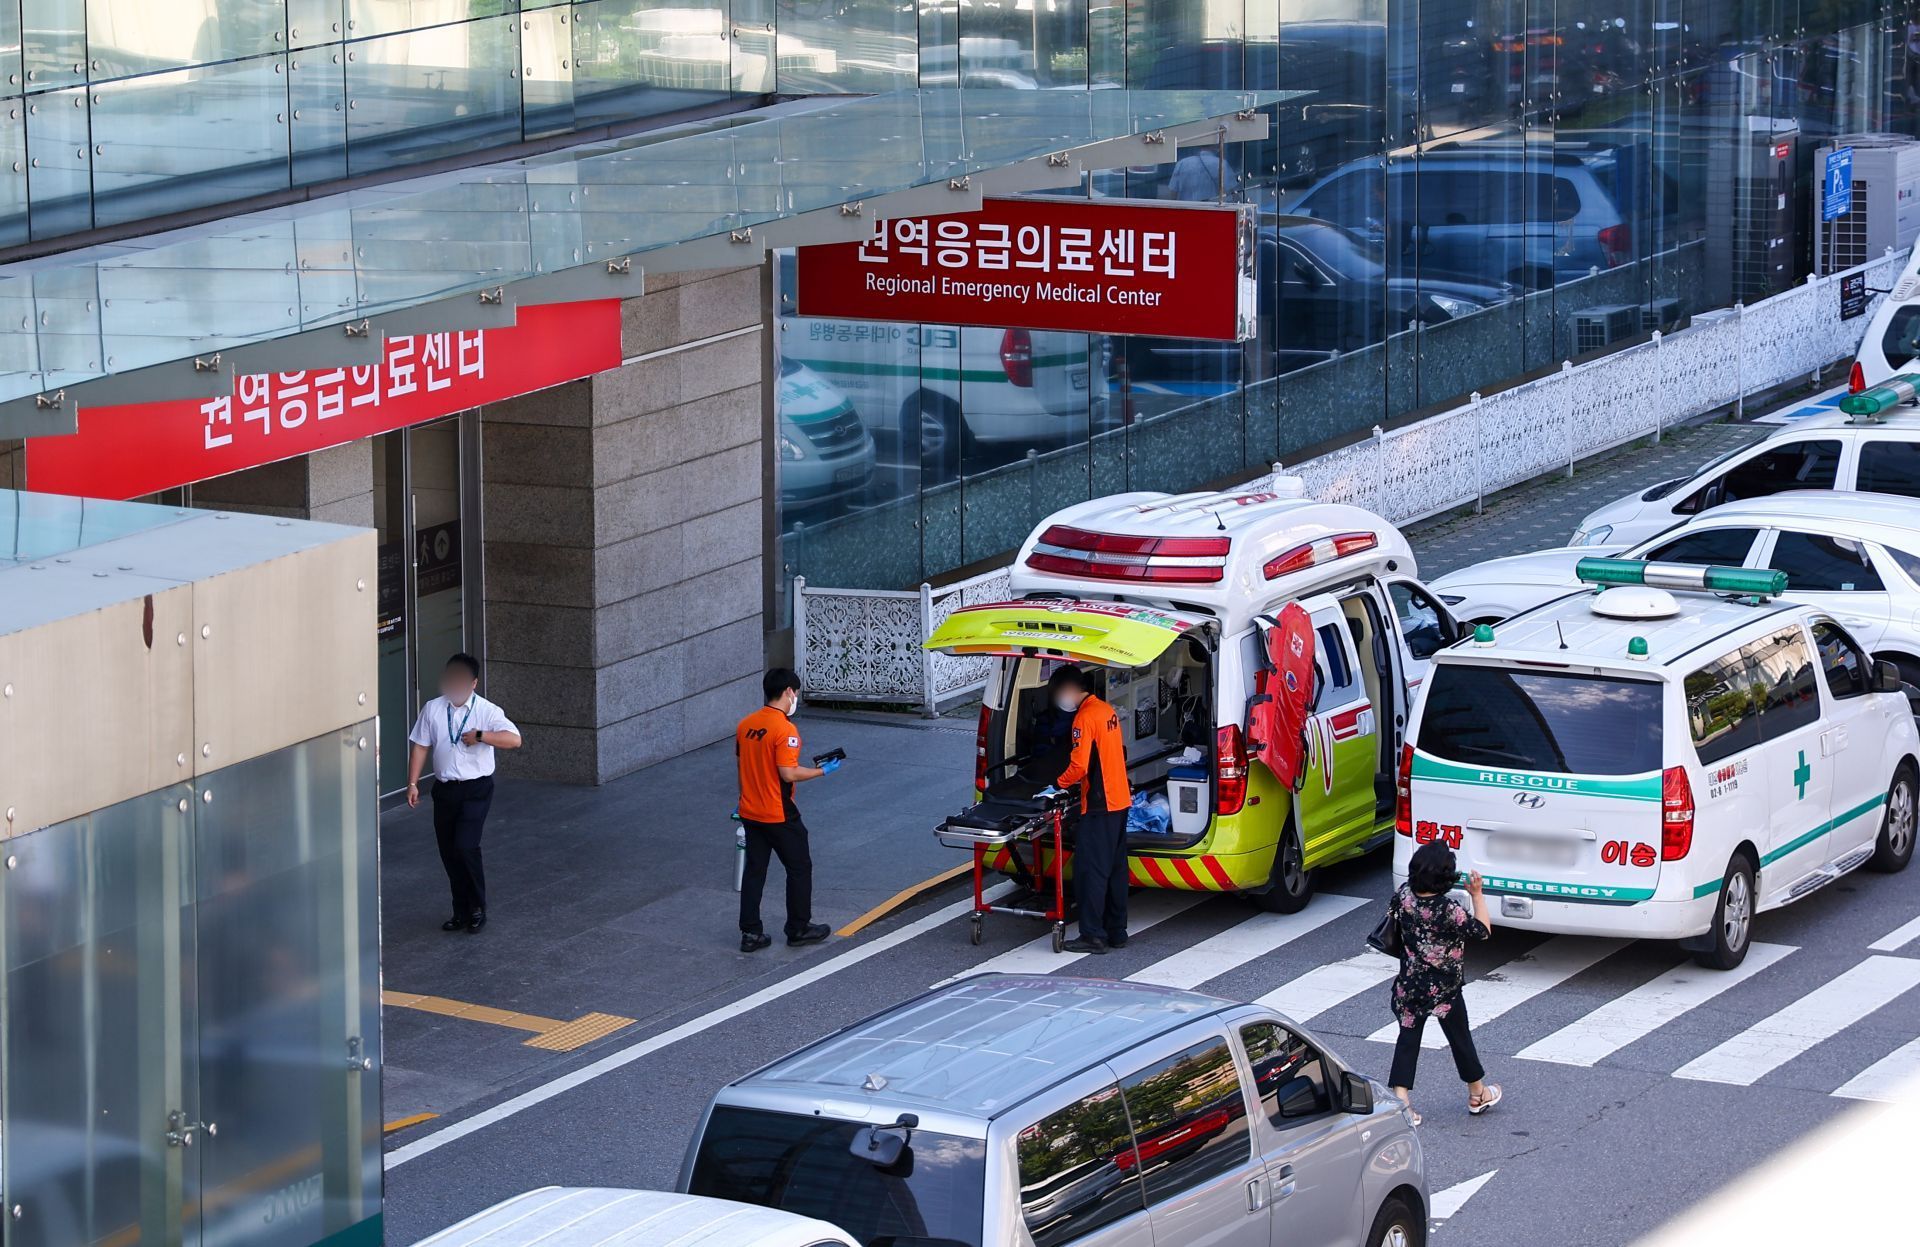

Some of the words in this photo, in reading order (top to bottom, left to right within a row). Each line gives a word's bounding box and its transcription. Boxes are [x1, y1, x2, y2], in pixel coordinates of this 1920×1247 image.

[866, 272, 936, 296] Regional
[942, 277, 1030, 303] Emergency
[1036, 282, 1100, 303] Medical
[1107, 286, 1162, 306] Center
[745, 728, 768, 741] 119
[1479, 772, 1579, 790] RESCUE
[1416, 820, 1464, 850] 환자
[1601, 840, 1657, 867] 이송
